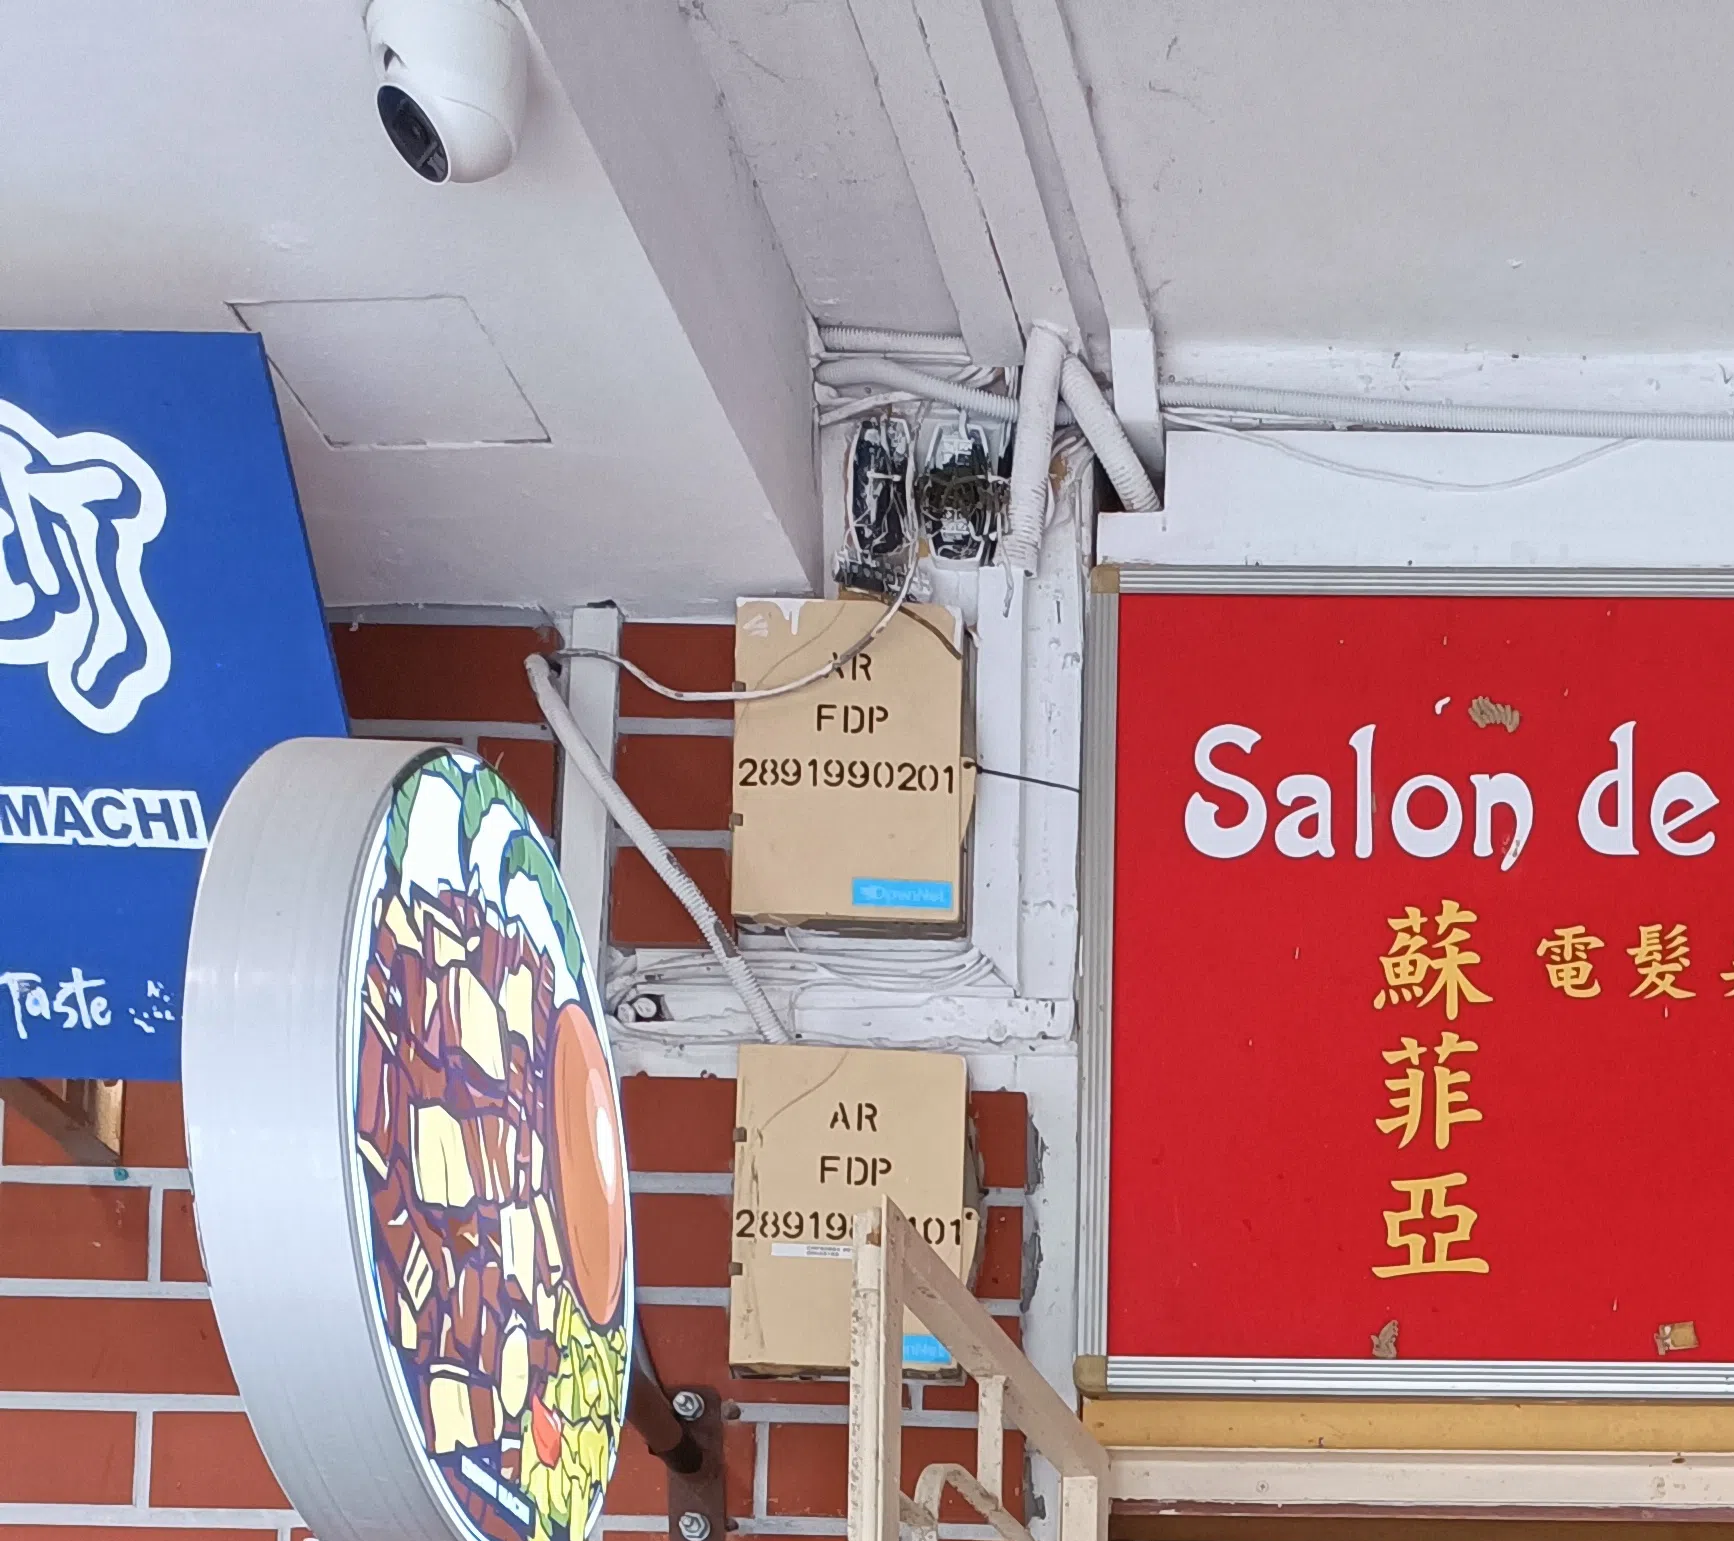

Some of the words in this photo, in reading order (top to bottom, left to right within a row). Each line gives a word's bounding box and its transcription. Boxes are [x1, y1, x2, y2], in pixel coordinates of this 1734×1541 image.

[816, 703, 889, 734] FDP
[738, 757, 954, 794] 2891990201
[1184, 722, 1535, 872] Salon
[1578, 720, 1720, 857] de
[0, 967, 111, 1039] Taste
[1372, 900, 1494, 1278] 蘇菲亞
[830, 1102, 878, 1132] AR
[820, 1155, 892, 1187] FDP
